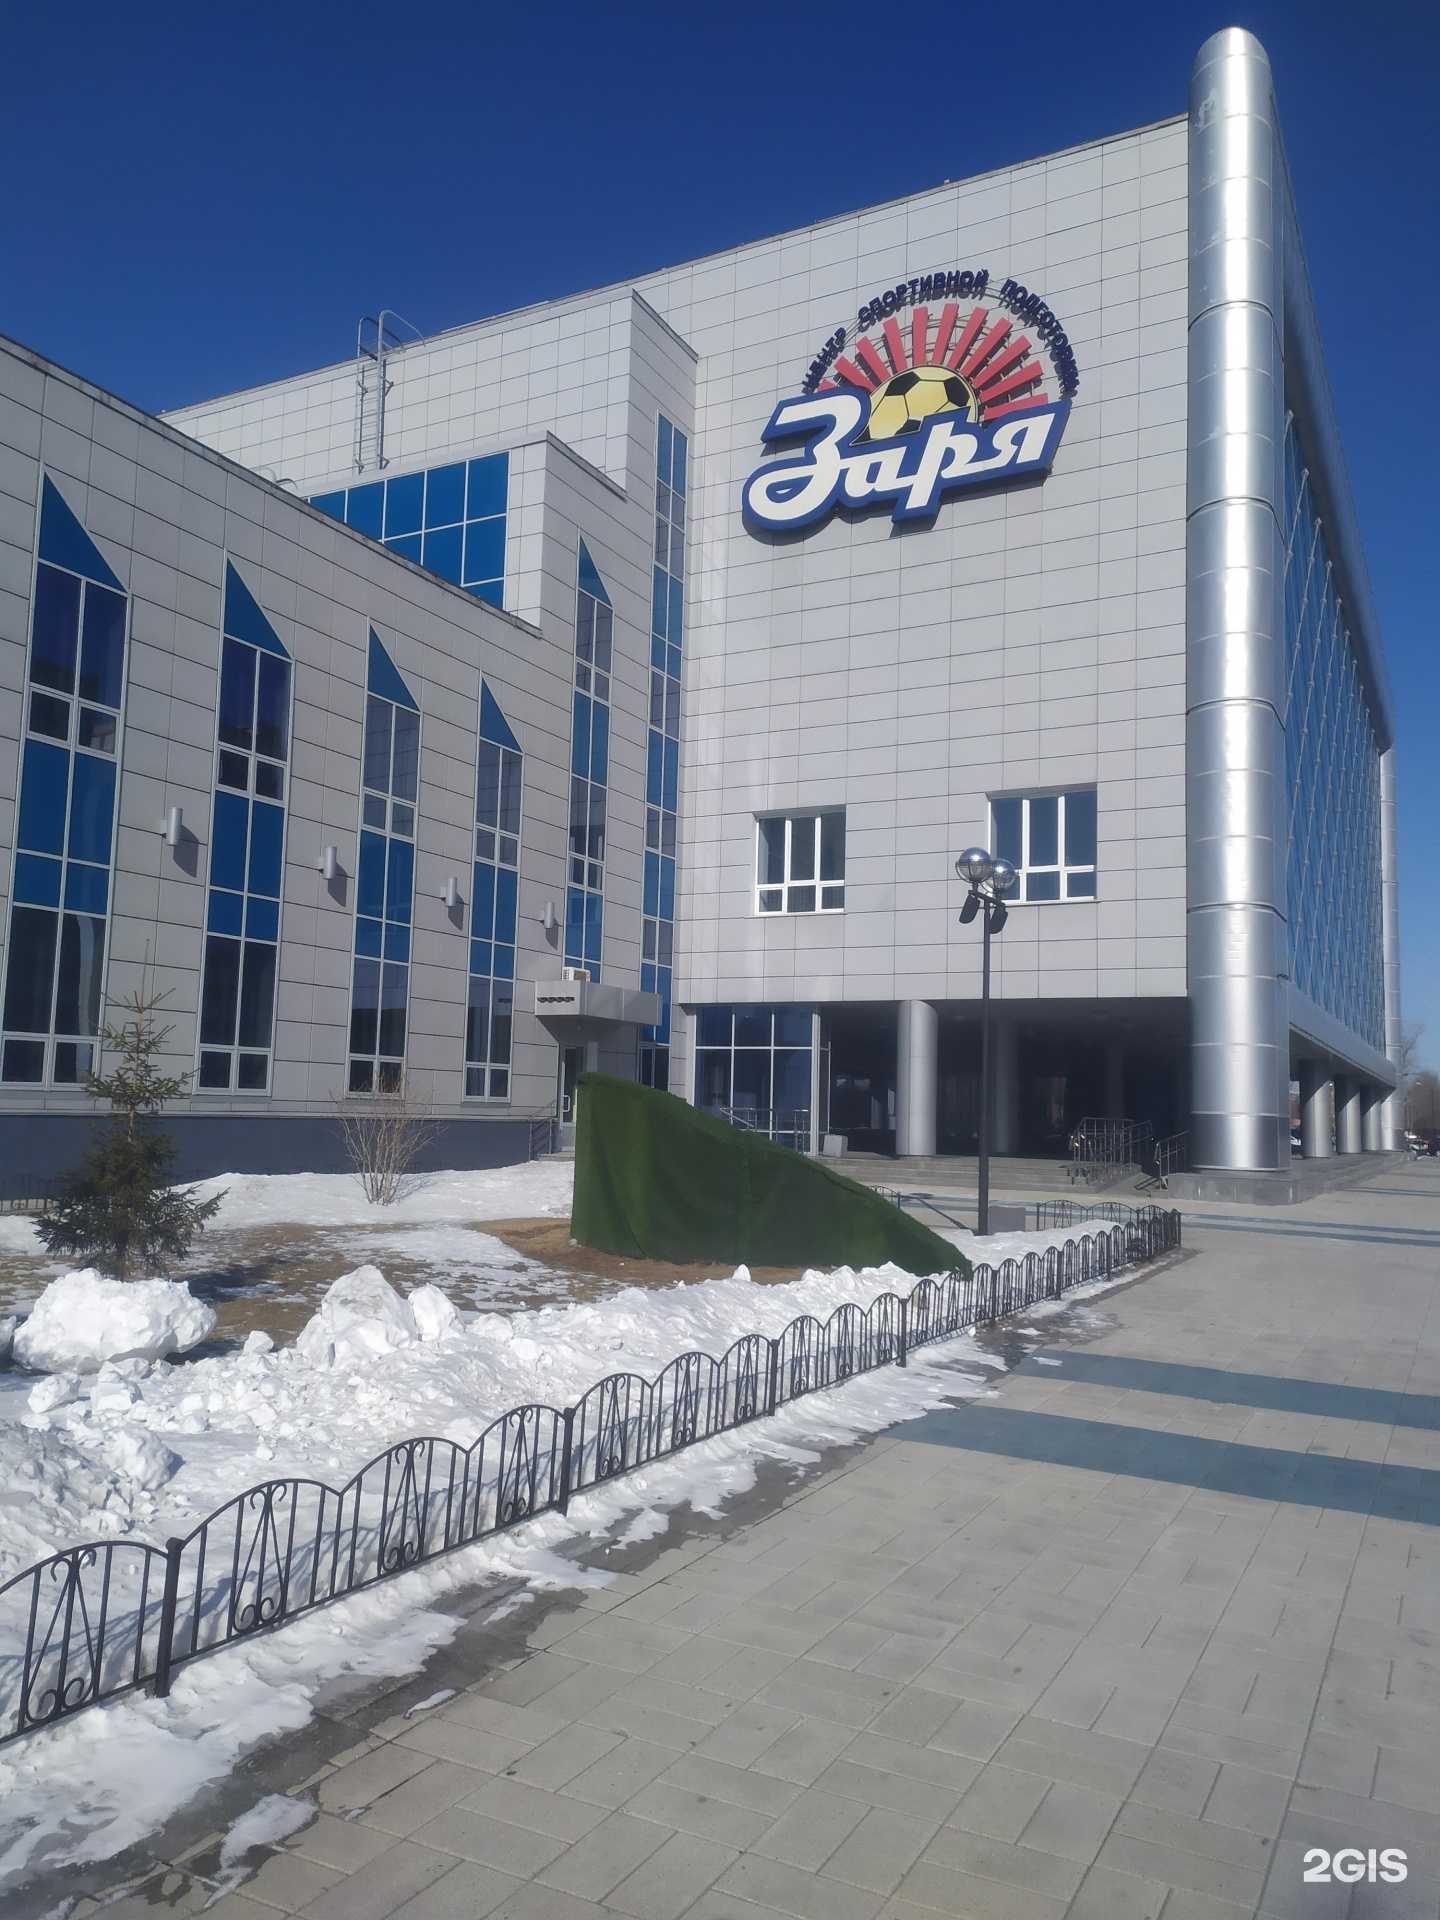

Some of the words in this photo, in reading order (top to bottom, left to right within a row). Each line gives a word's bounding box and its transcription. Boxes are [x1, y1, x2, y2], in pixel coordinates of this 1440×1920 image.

[858, 269, 989, 323] СПОРТИВНОЙ
[1000, 279, 1080, 392] ПОДГОТОВКИ
[748, 394, 1056, 522] Заря
